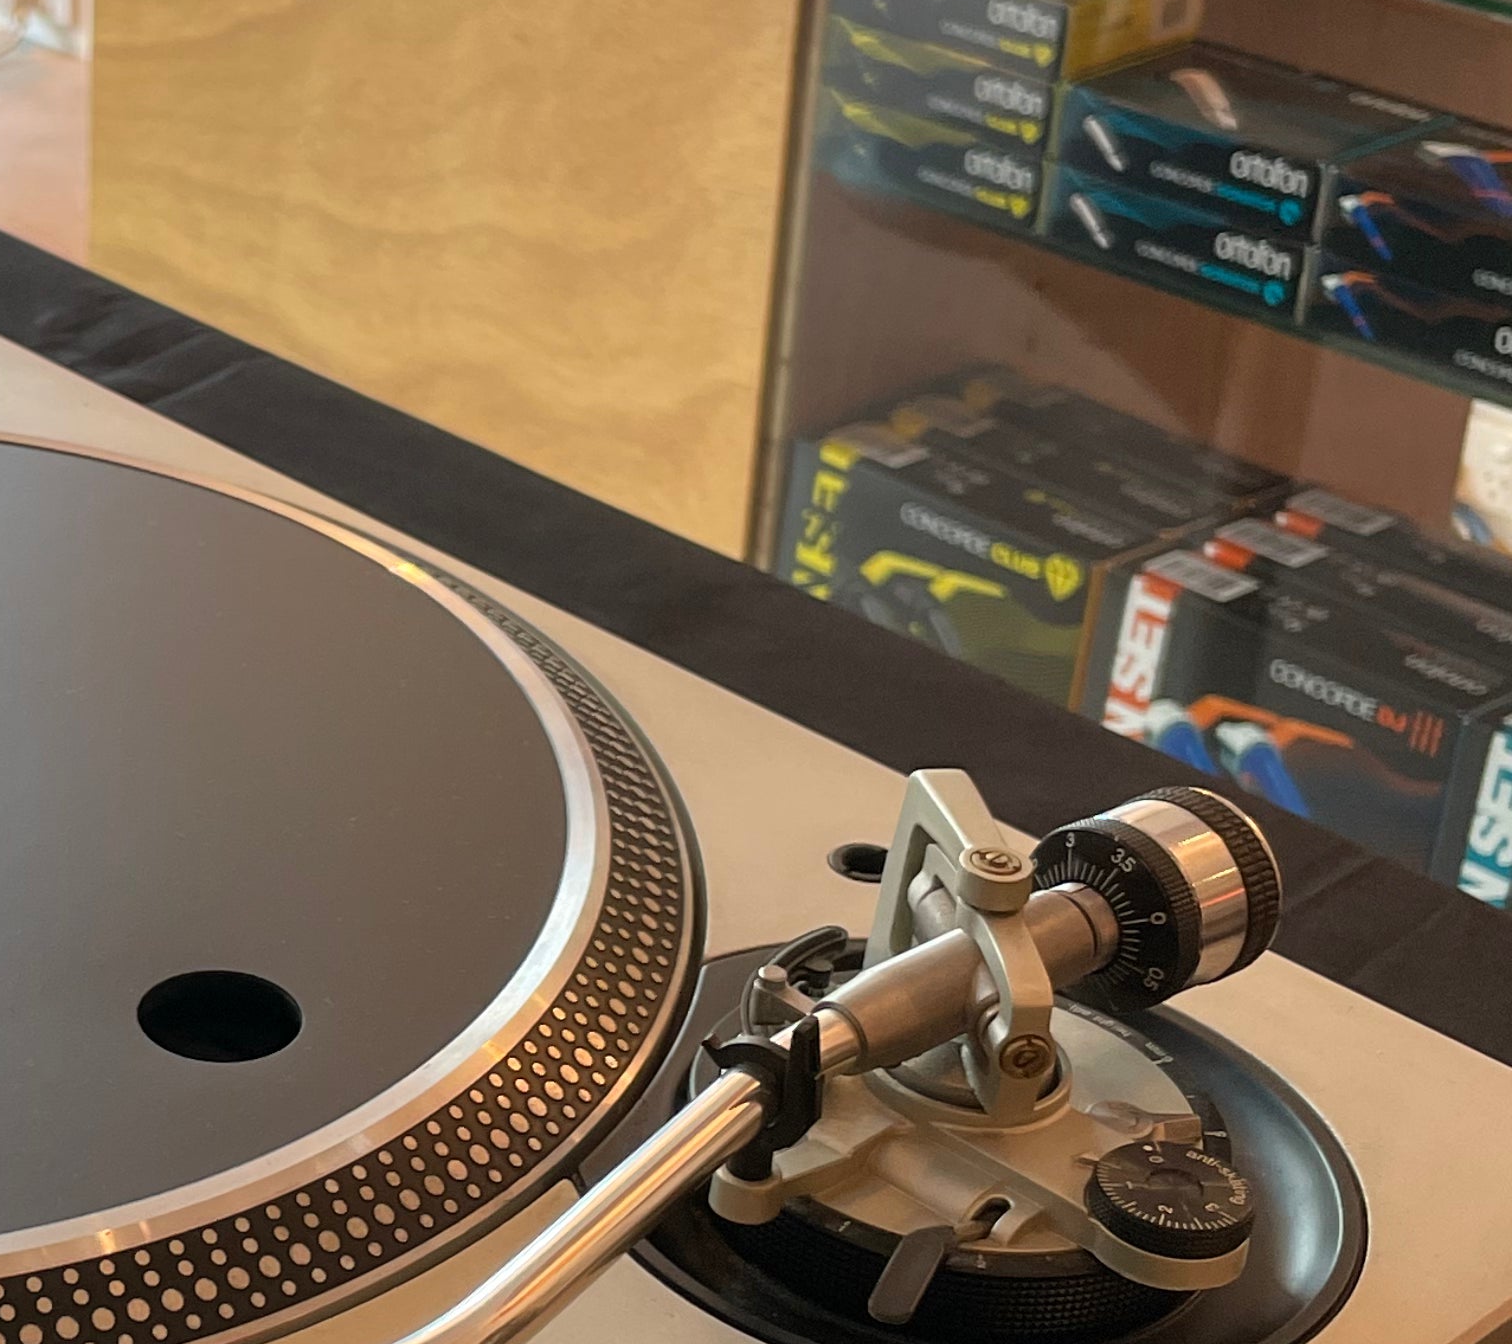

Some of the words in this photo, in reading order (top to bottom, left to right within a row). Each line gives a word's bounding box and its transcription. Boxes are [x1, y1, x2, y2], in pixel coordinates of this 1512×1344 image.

[1229, 150, 1309, 197] ortofon
[1214, 231, 1291, 280] ortofon
[1270, 659, 1378, 722] CONCORDE
[1065, 832, 1075, 847] 3
[1150, 912, 1166, 925] 0
[1149, 1155, 1164, 1163] 0
[1158, 1205, 1174, 1214] 2
[1186, 1150, 1249, 1205] anti-skating
